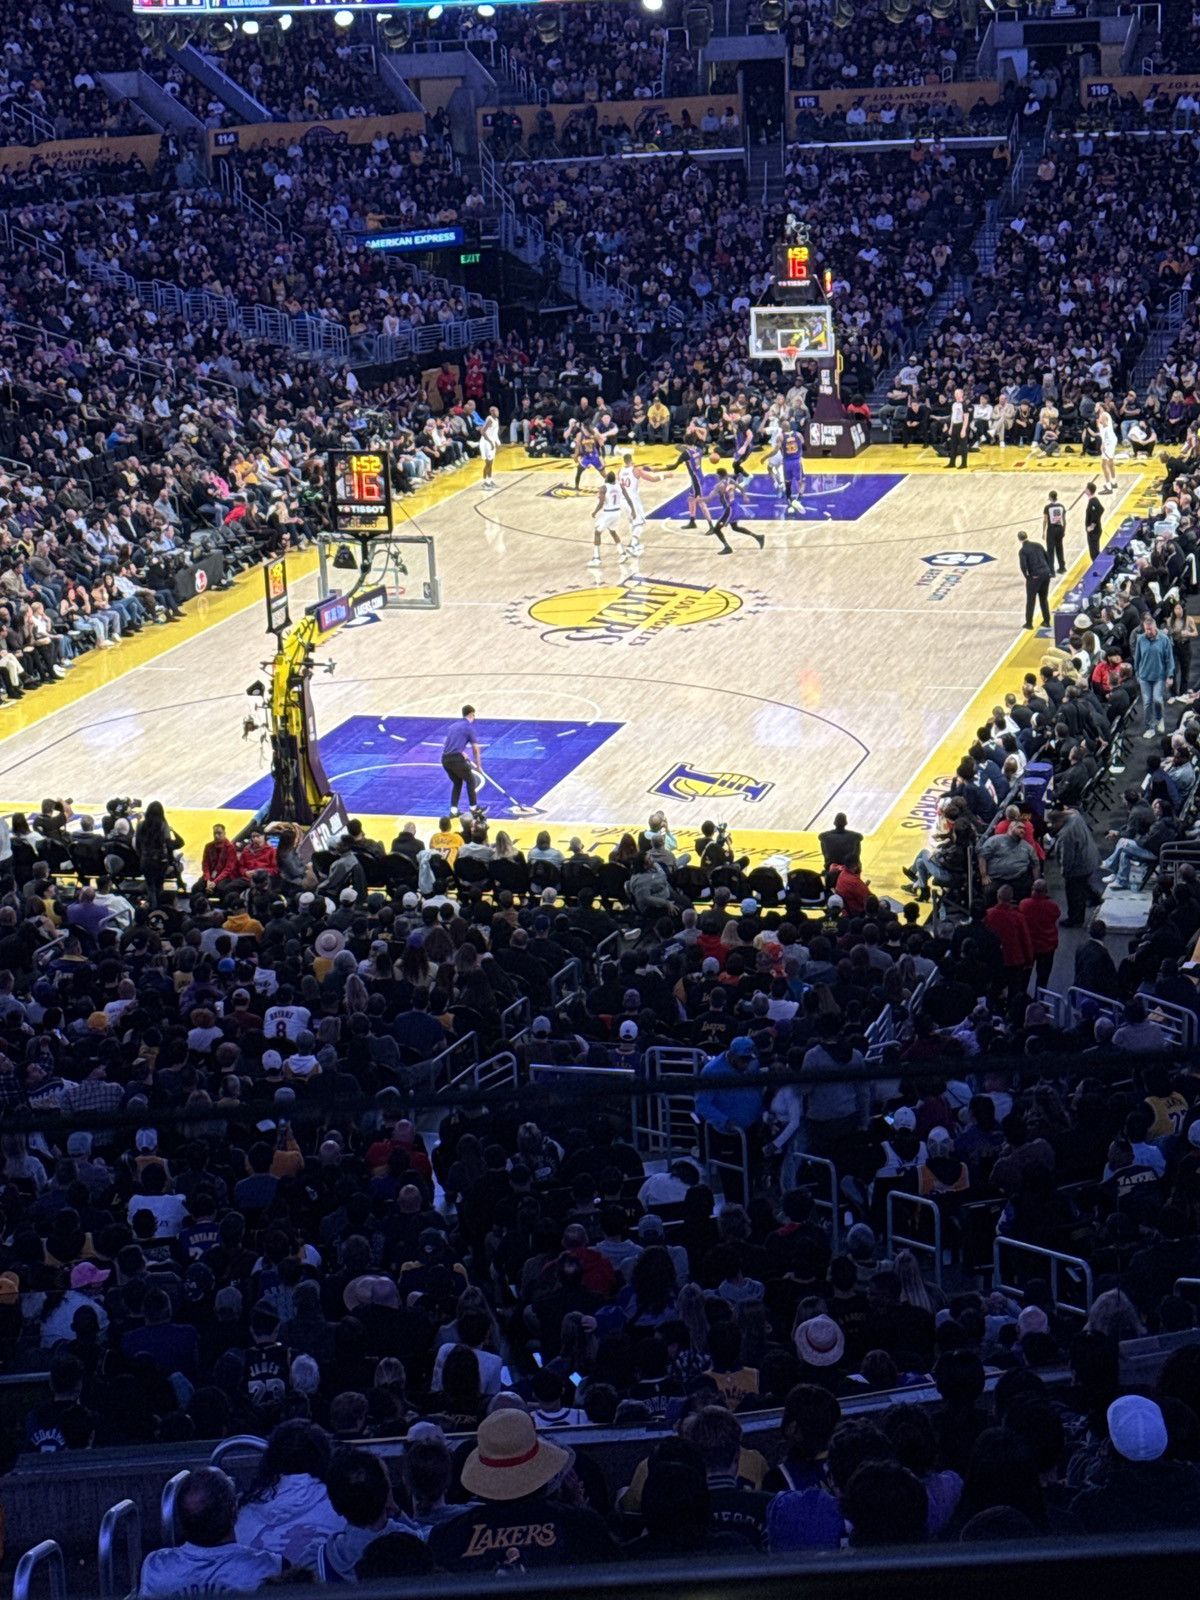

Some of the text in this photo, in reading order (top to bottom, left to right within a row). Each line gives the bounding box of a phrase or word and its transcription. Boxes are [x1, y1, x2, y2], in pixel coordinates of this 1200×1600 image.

[797, 96, 815, 107] 115
[217, 133, 235, 144] 114
[365, 232, 456, 248] AMERICAN EXPRESS
[460, 253, 480, 264] EXIT
[789, 258, 807, 278] 16
[352, 455, 382, 473] 1:52
[353, 473, 380, 500] 16
[351, 505, 386, 514] TISSOT
[269, 1010, 294, 1020] BRYANT
[276, 1020, 287, 1038] 8
[189, 1232, 219, 1245] BRYANT
[250, 1361, 280, 1378] JAMES
[460, 1522, 557, 1558] LAKERS
